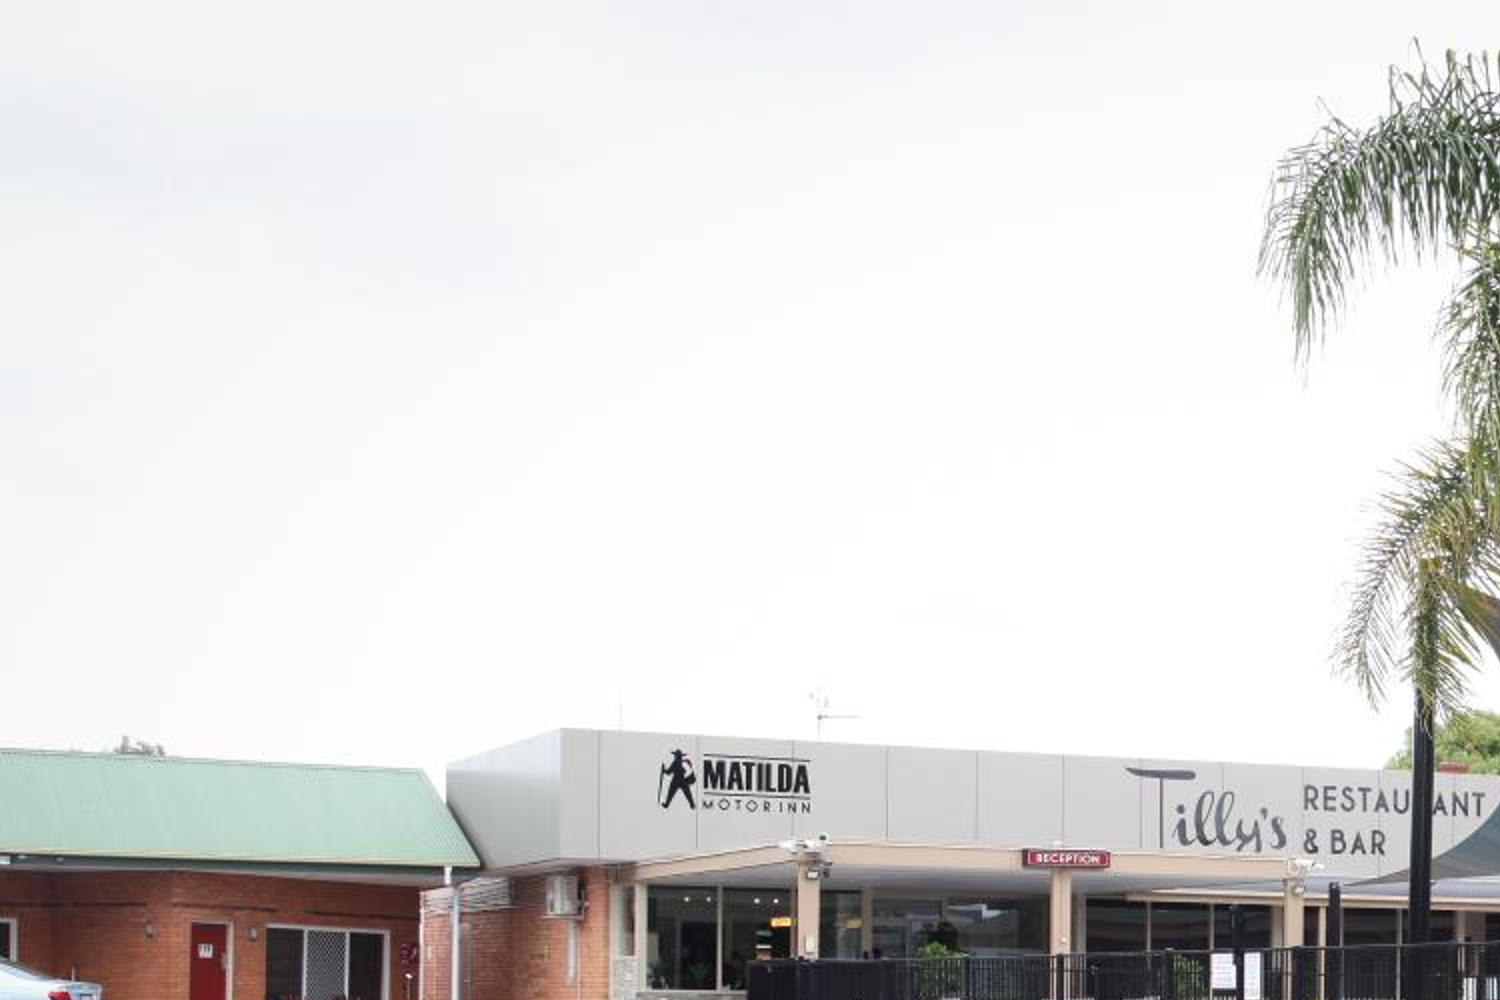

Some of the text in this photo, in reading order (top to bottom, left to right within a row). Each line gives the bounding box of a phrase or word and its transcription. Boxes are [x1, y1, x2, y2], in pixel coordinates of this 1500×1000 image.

[703, 759, 811, 794] MATILDA
[703, 798, 811, 814] MOTOR INN
[1125, 767, 1287, 853] Tilly's
[1303, 784, 1486, 817] RESTAUANT
[1303, 828, 1386, 856] & BAR
